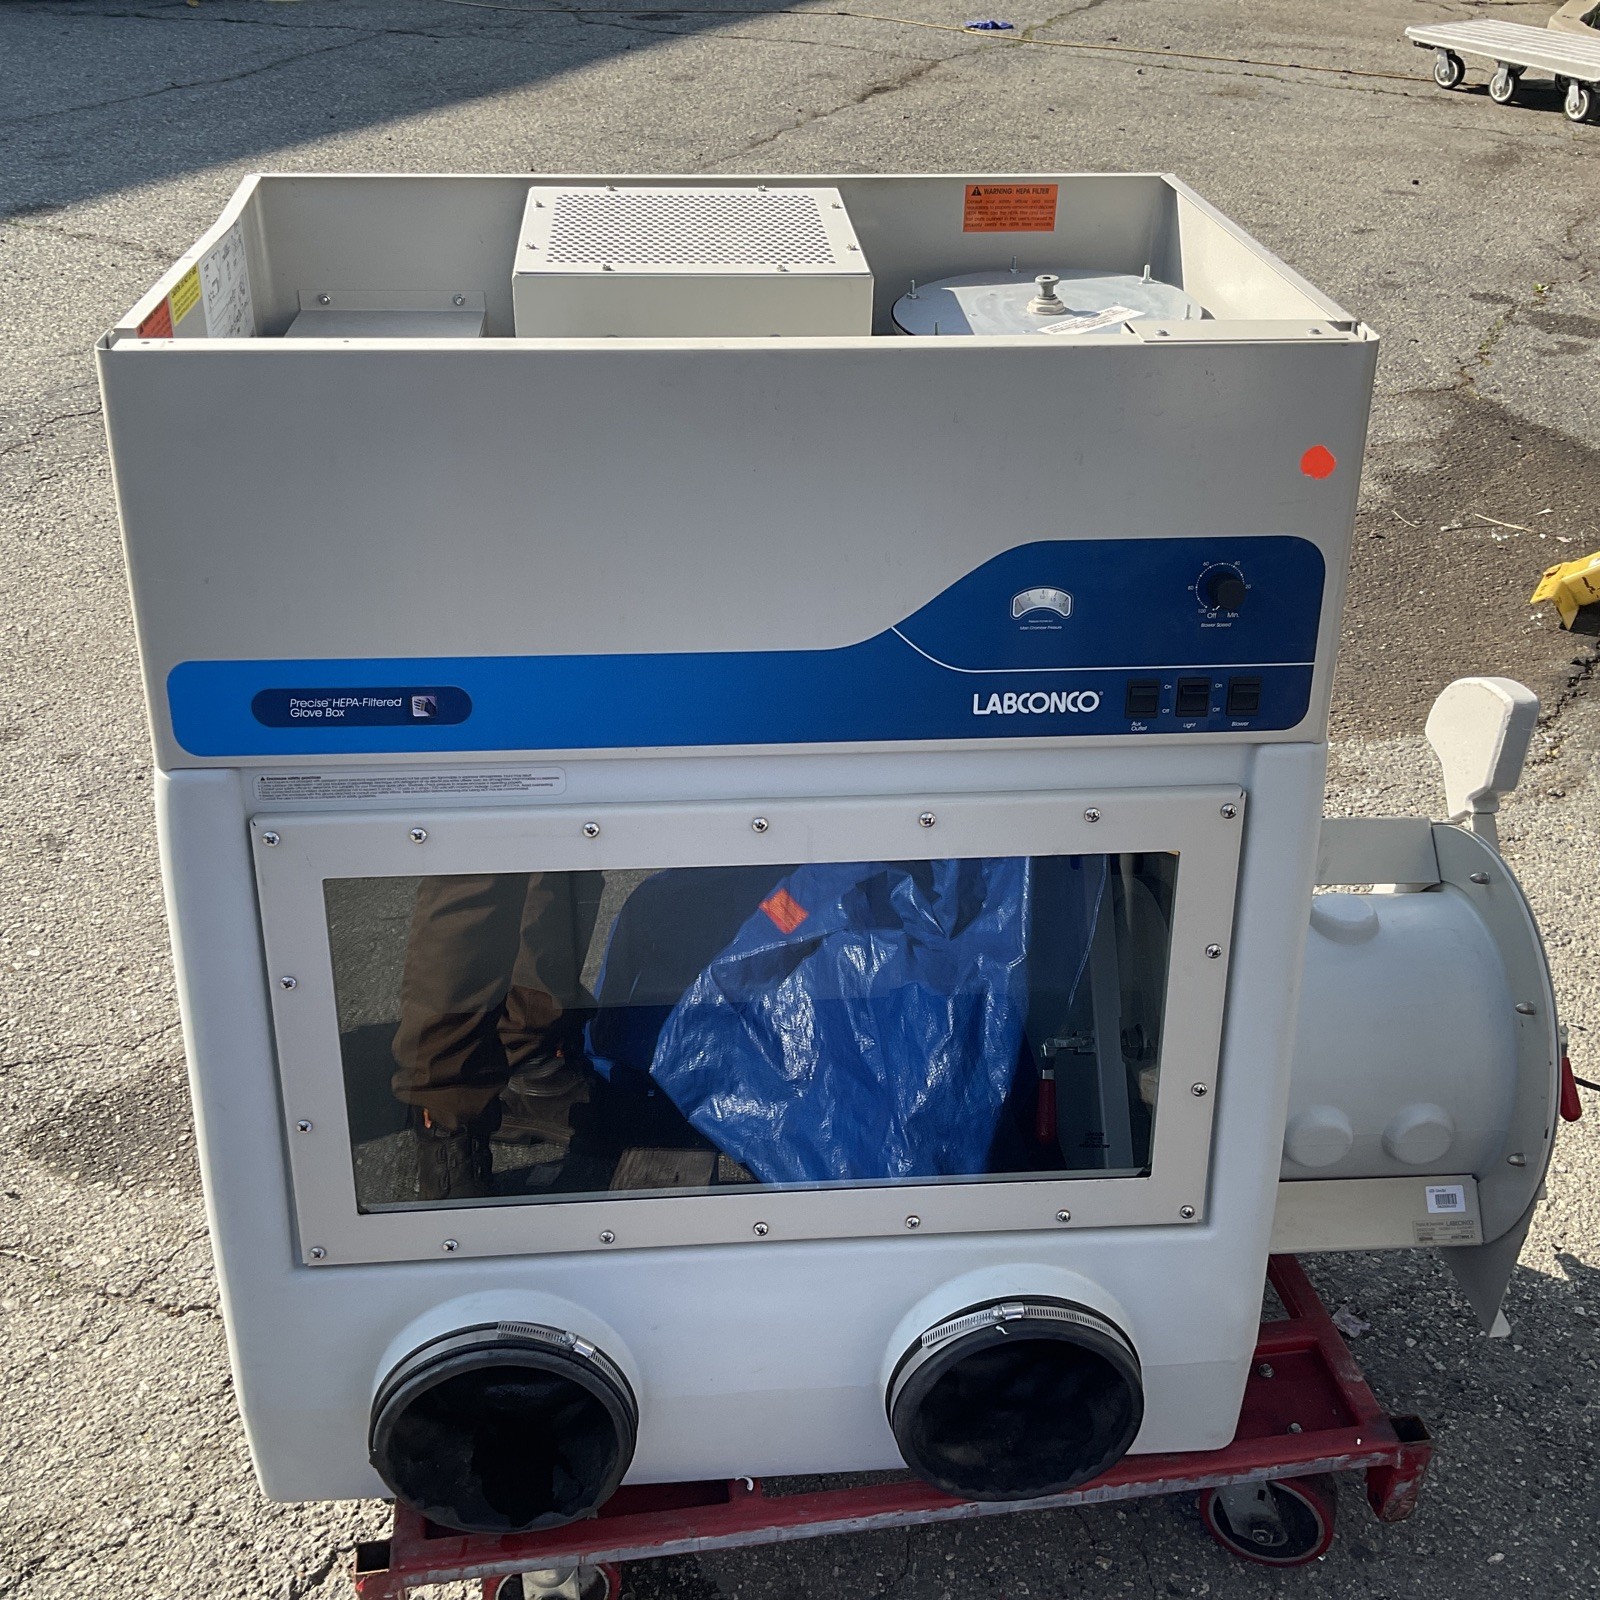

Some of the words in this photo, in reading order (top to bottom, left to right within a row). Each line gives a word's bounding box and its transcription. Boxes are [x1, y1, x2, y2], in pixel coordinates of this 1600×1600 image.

[332, 697, 402, 707] HEPA-Filtered
[290, 708, 323, 718] Glove
[325, 707, 345, 717] Box
